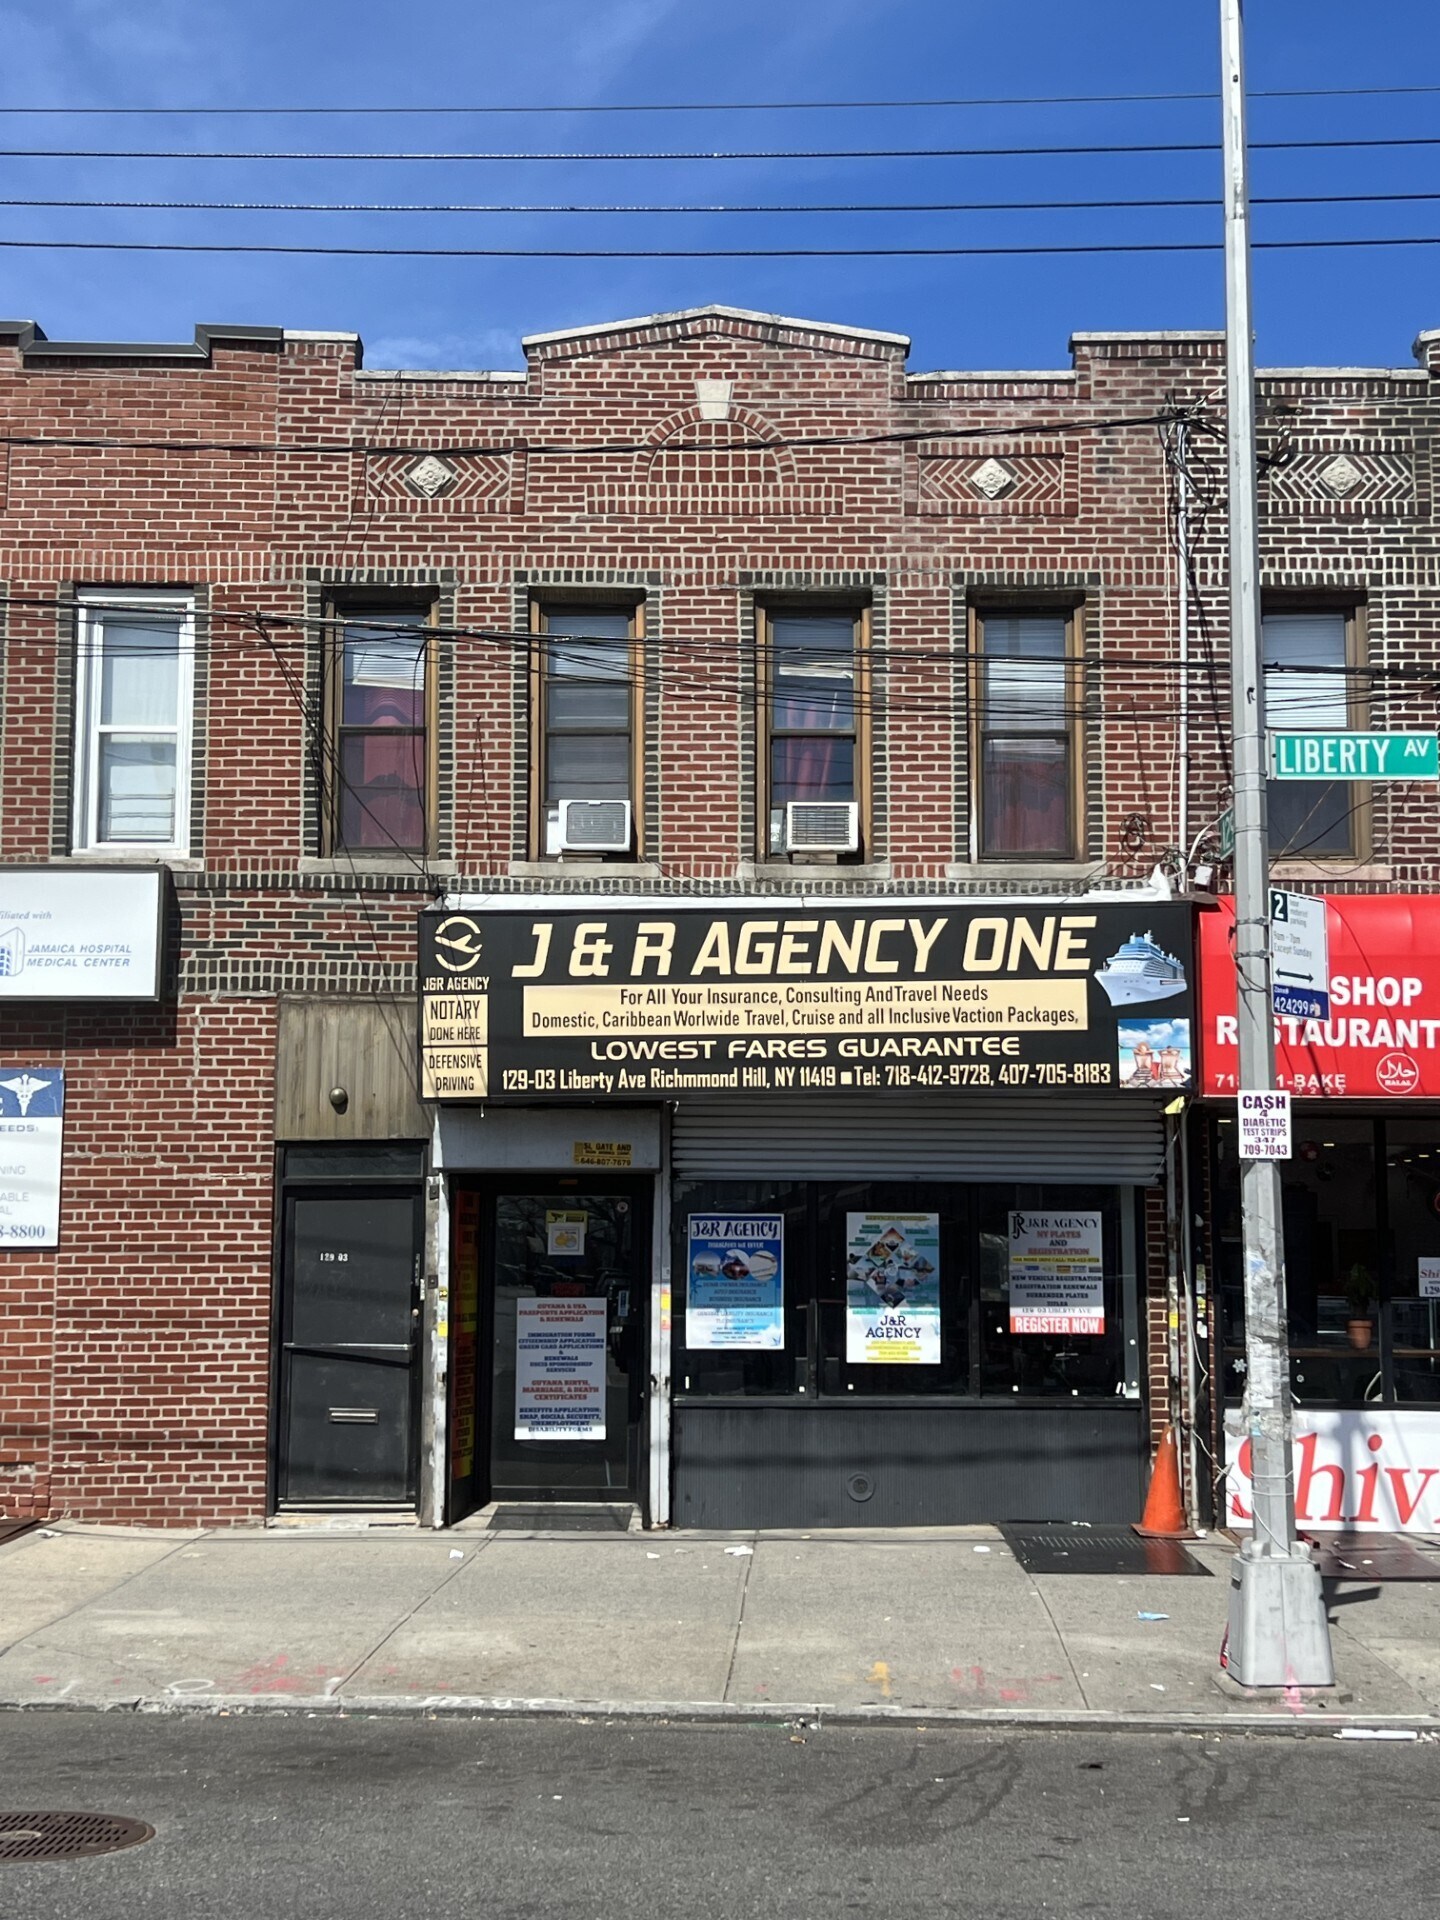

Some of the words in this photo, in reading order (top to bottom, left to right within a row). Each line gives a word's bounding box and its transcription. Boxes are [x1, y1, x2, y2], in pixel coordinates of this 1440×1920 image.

[1280, 739, 1390, 773] LIBERTY
[1404, 739, 1429, 757] AV
[1274, 893, 1284, 919] 2
[33, 911, 52, 919] with
[28, 944, 75, 953] JAMAICA
[80, 944, 132, 953] HOSPITAL
[511, 923, 553, 978] J
[568, 922, 614, 976] &
[630, 922, 676, 976] R
[690, 918, 949, 976] AGENCY
[962, 915, 1097, 972] ONE
[1274, 942, 1293, 956] Except
[1293, 946, 1312, 959] Sunday
[27, 958, 78, 967] MEDICAL
[84, 958, 131, 967] CENTER
[423, 976, 444, 991] J&R
[446, 976, 490, 991] AGENCY
[1330, 976, 1423, 1006] SHOP
[620, 989, 643, 1005] For
[646, 988, 668, 1005] All
[672, 988, 703, 1005] Your
[707, 987, 783, 1006] Insurance,
[786, 986, 861, 1006] Consulting
[942, 984, 989, 1001] Needs
[430, 999, 481, 1021] NOTARY
[1274, 996, 1308, 1015] 424299
[531, 1011, 600, 1030] Domestic,
[744, 1009, 790, 1028] Travel,
[792, 1008, 835, 1026] Cruise
[838, 1007, 863, 1025] and
[867, 1007, 884, 1024] all
[1007, 1005, 1079, 1026] Packages,
[430, 1026, 455, 1041] DONE
[457, 1025, 480, 1041] HERE
[1215, 1015, 1440, 1049] RTAURANT
[590, 1040, 717, 1060] LOWEST
[727, 1038, 828, 1059] FARES
[838, 1036, 1021, 1058] GUARANTEE
[429, 1053, 483, 1070] DEFENSIVE
[1379, 1059, 1416, 1079] حلال
[436, 1075, 475, 1092] DRIVING
[502, 1068, 555, 1090] 129-03
[560, 1068, 614, 1093] Liberty
[618, 1068, 646, 1089] Ave
[650, 1067, 738, 1089] Richmmond
[742, 1067, 771, 1091] Hill,
[774, 1066, 796, 1087] NY
[799, 1065, 836, 1087] 11419
[853, 1065, 880, 1087] Tel:
[885, 1063, 995, 1088] 718-412-9728,
[998, 1063, 1111, 1086] 407-705-8183
[1259, 1109, 1268, 1117] 4
[1243, 1118, 1286, 1127] DIABETIC
[1243, 1128, 1260, 1136] TEST
[1261, 1128, 1287, 1136] STRIPS
[595, 1143, 613, 1151] GATE
[616, 1143, 632, 1151] AND
[1243, 1144, 1288, 1156] 709-7043
[693, 1221, 721, 1238] J&R
[723, 1221, 778, 1239] AGENCY
[1051, 1218, 1099, 1228] AGENCY
[1050, 1230, 1081, 1238] PLATES
[320, 1252, 335, 1262] 129
[338, 1252, 348, 1262] 03
[880, 1315, 906, 1326] J&R
[1015, 1317, 1070, 1333] REGISTER
[1072, 1318, 1099, 1334] NOW
[865, 1327, 922, 1339] AGENCY
[534, 1393, 588, 1401] CERTIFICATES
[1231, 1432, 1440, 1526] hiv
